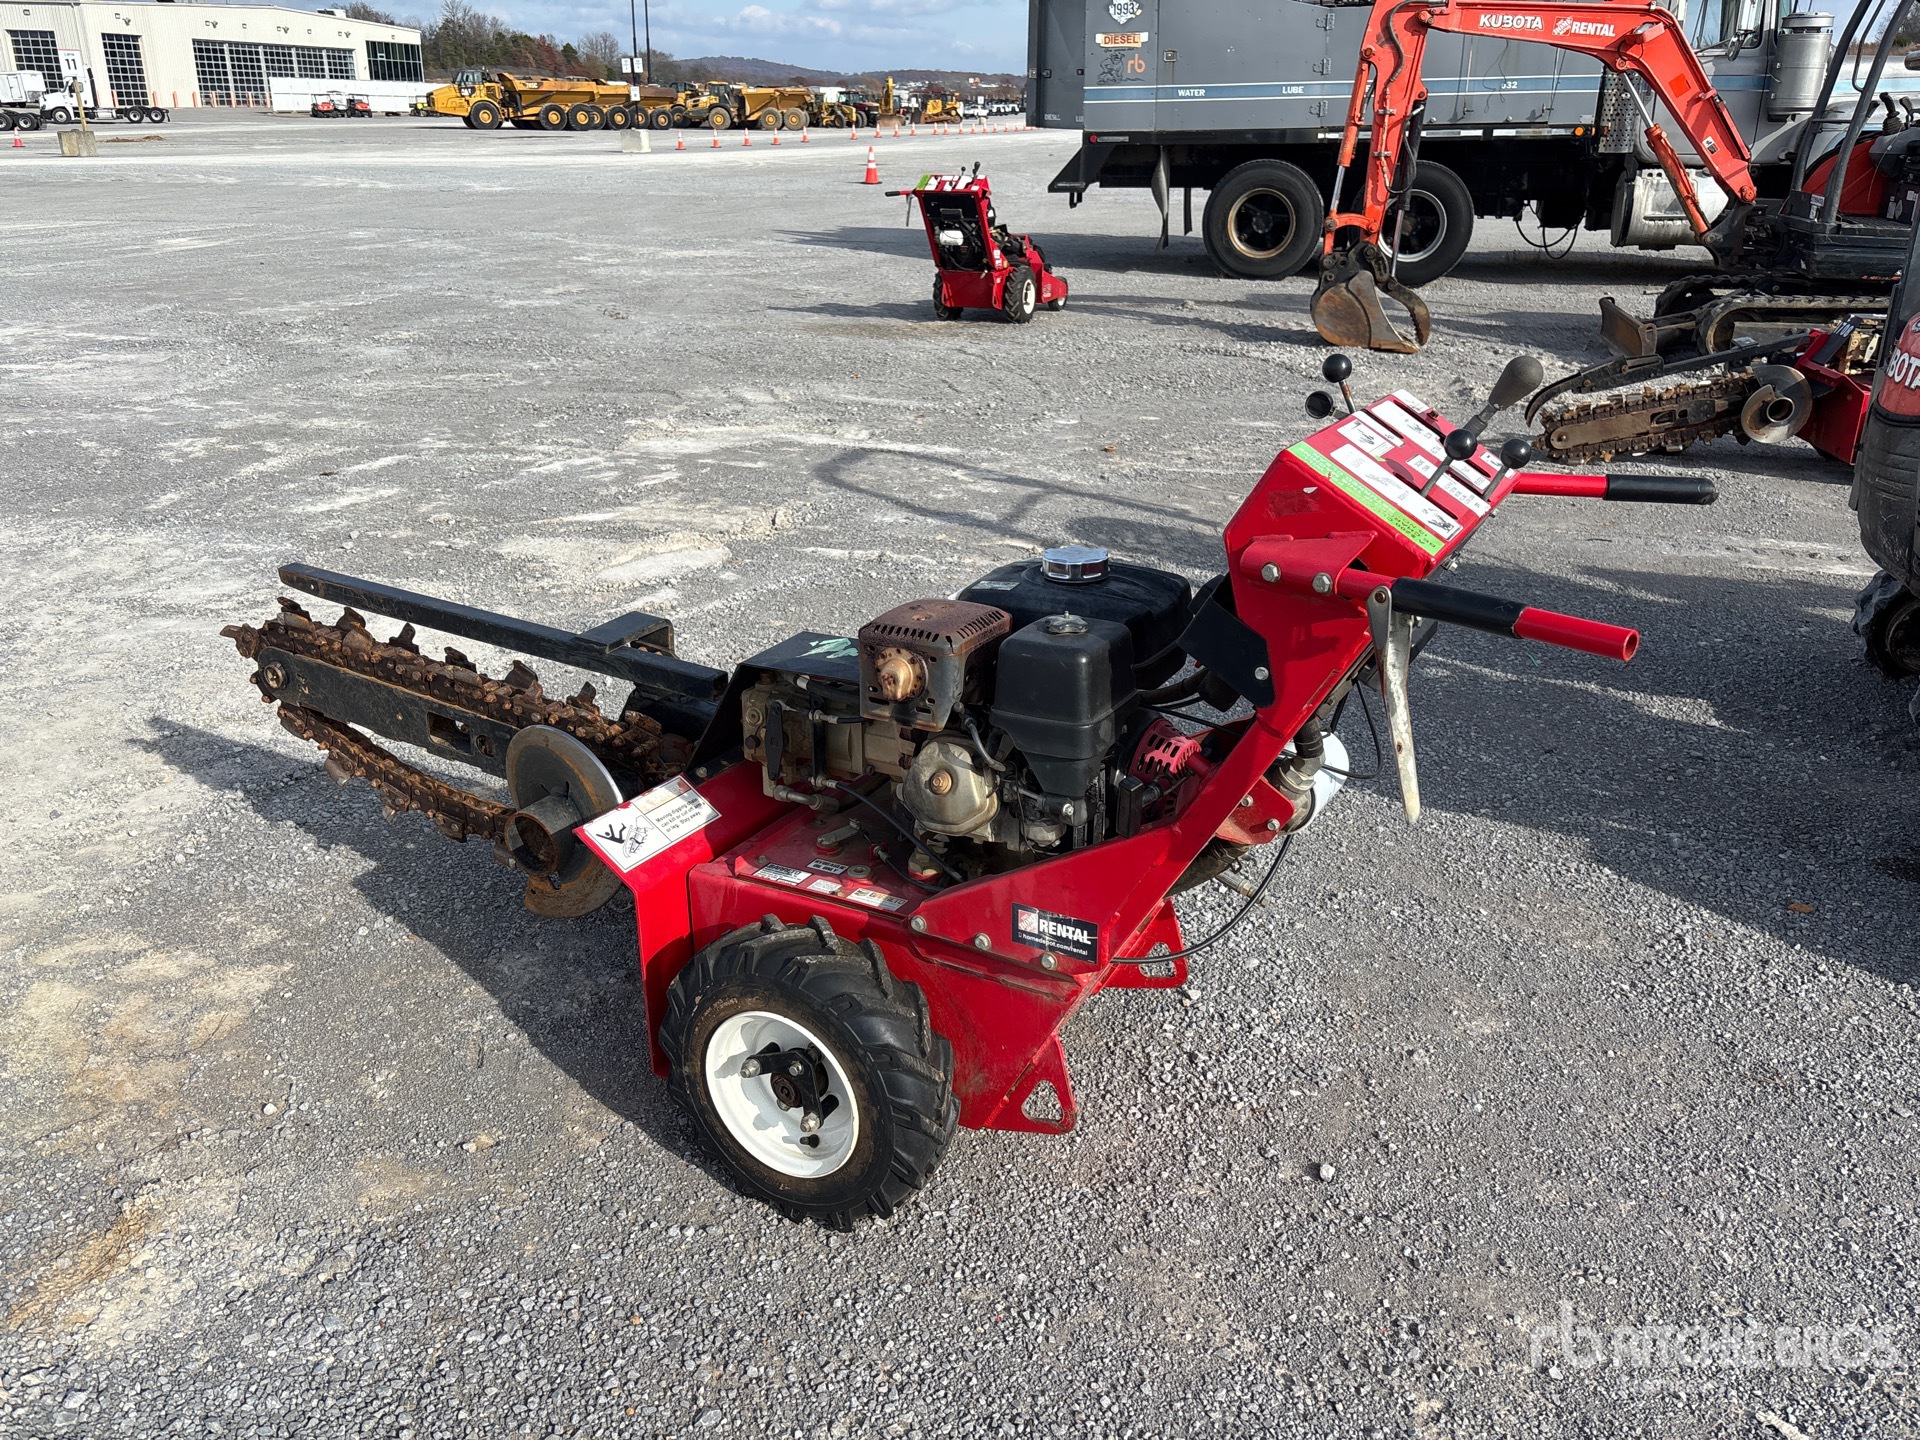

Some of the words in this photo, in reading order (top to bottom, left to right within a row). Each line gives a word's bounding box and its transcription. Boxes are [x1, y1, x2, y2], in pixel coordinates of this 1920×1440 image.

[1113, 2, 1134, 15] 1993
[1479, 14, 1543, 30] KUBOTA
[1571, 22, 1616, 37] RENTAL
[1104, 36, 1139, 44] DIESEL
[65, 58, 77, 70] 11
[1127, 53, 1146, 74] rb
[1296, 446, 1341, 478] MACHINE
[1300, 454, 1325, 472] WILL
[1310, 452, 1344, 476] CLEAN
[1340, 477, 1363, 494] THIS
[1343, 475, 1396, 514] RETURNED
[1373, 501, 1421, 537] CHARGED
[1397, 514, 1417, 529] NOT
[1394, 521, 1416, 538] $200
[656, 811, 673, 822] Moving
[670, 803, 688, 814] digging
[680, 816, 691, 824] Stay
[1039, 918, 1092, 945] RENTAL
[1022, 933, 1088, 956] homedepot.com/rental
